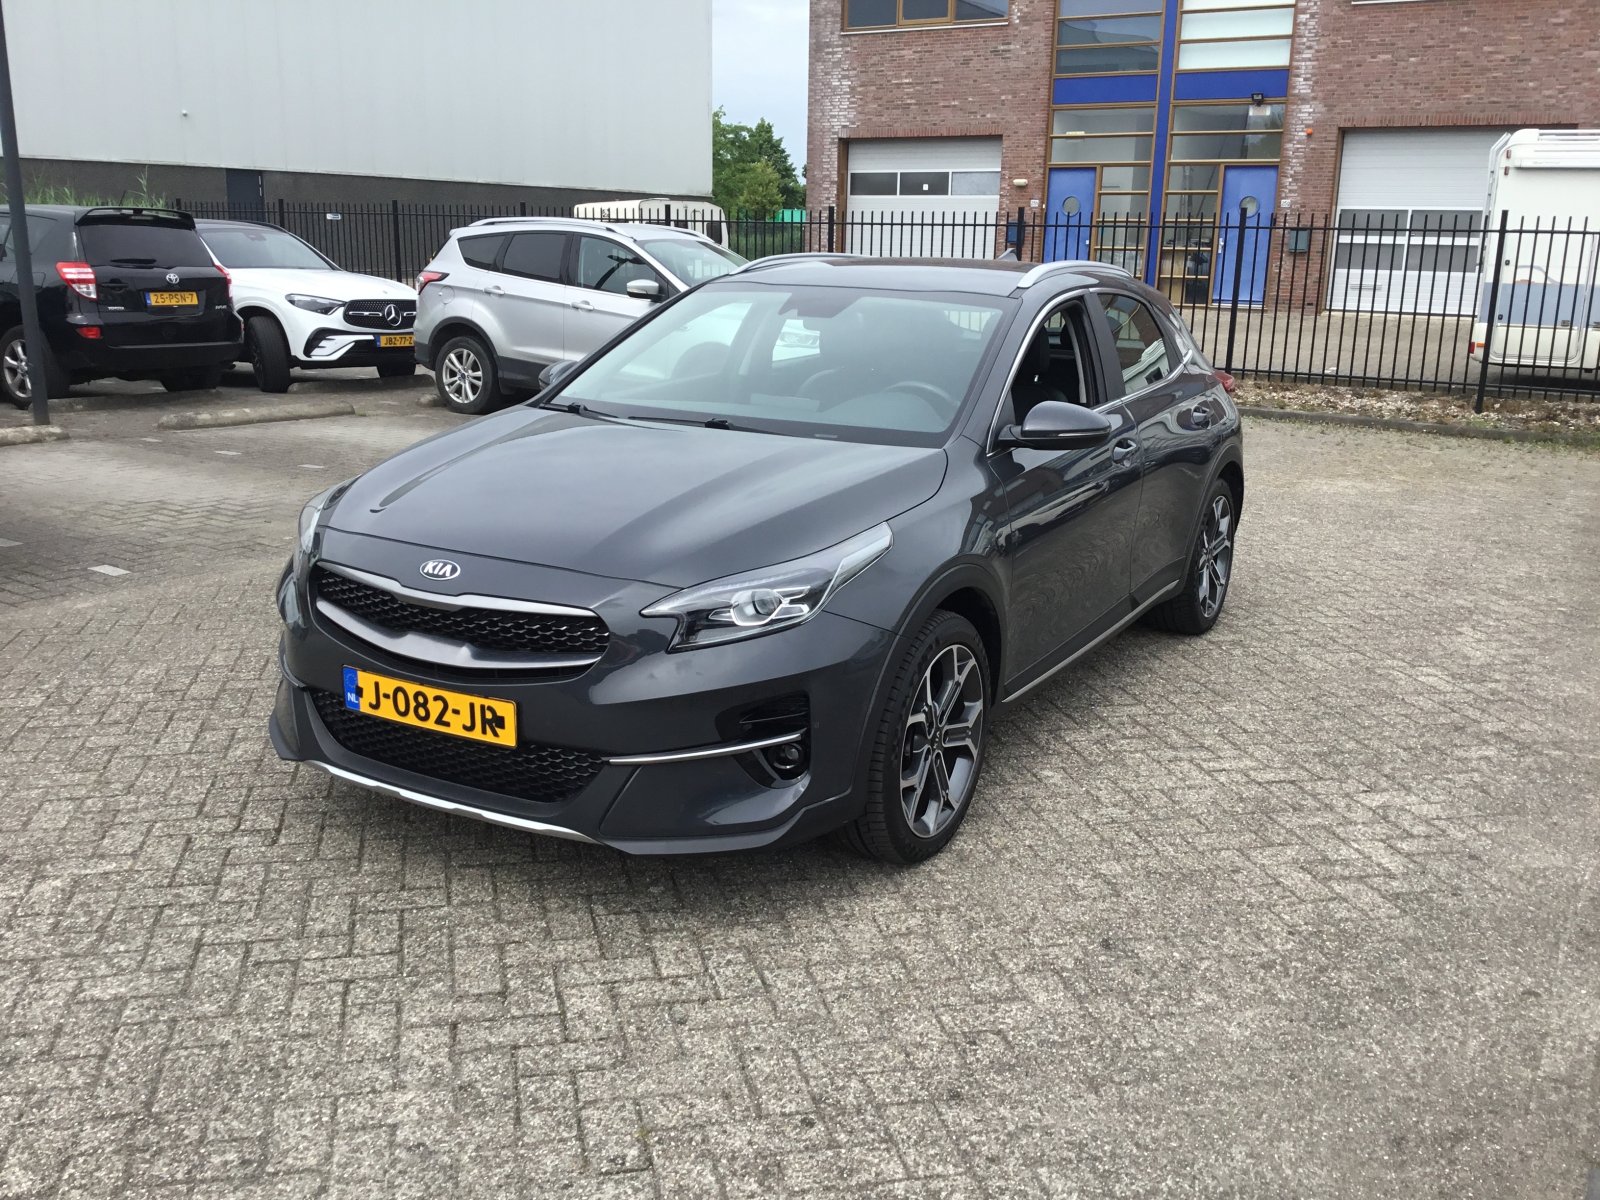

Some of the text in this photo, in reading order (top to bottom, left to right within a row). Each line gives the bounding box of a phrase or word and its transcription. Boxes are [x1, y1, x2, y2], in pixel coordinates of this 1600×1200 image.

[154, 293, 195, 304] 25-PSN-7
[384, 336, 413, 346] JBZ-77-Z
[423, 561, 453, 577] KIA
[347, 692, 359, 704] NL
[368, 681, 500, 738] J-082-JR
